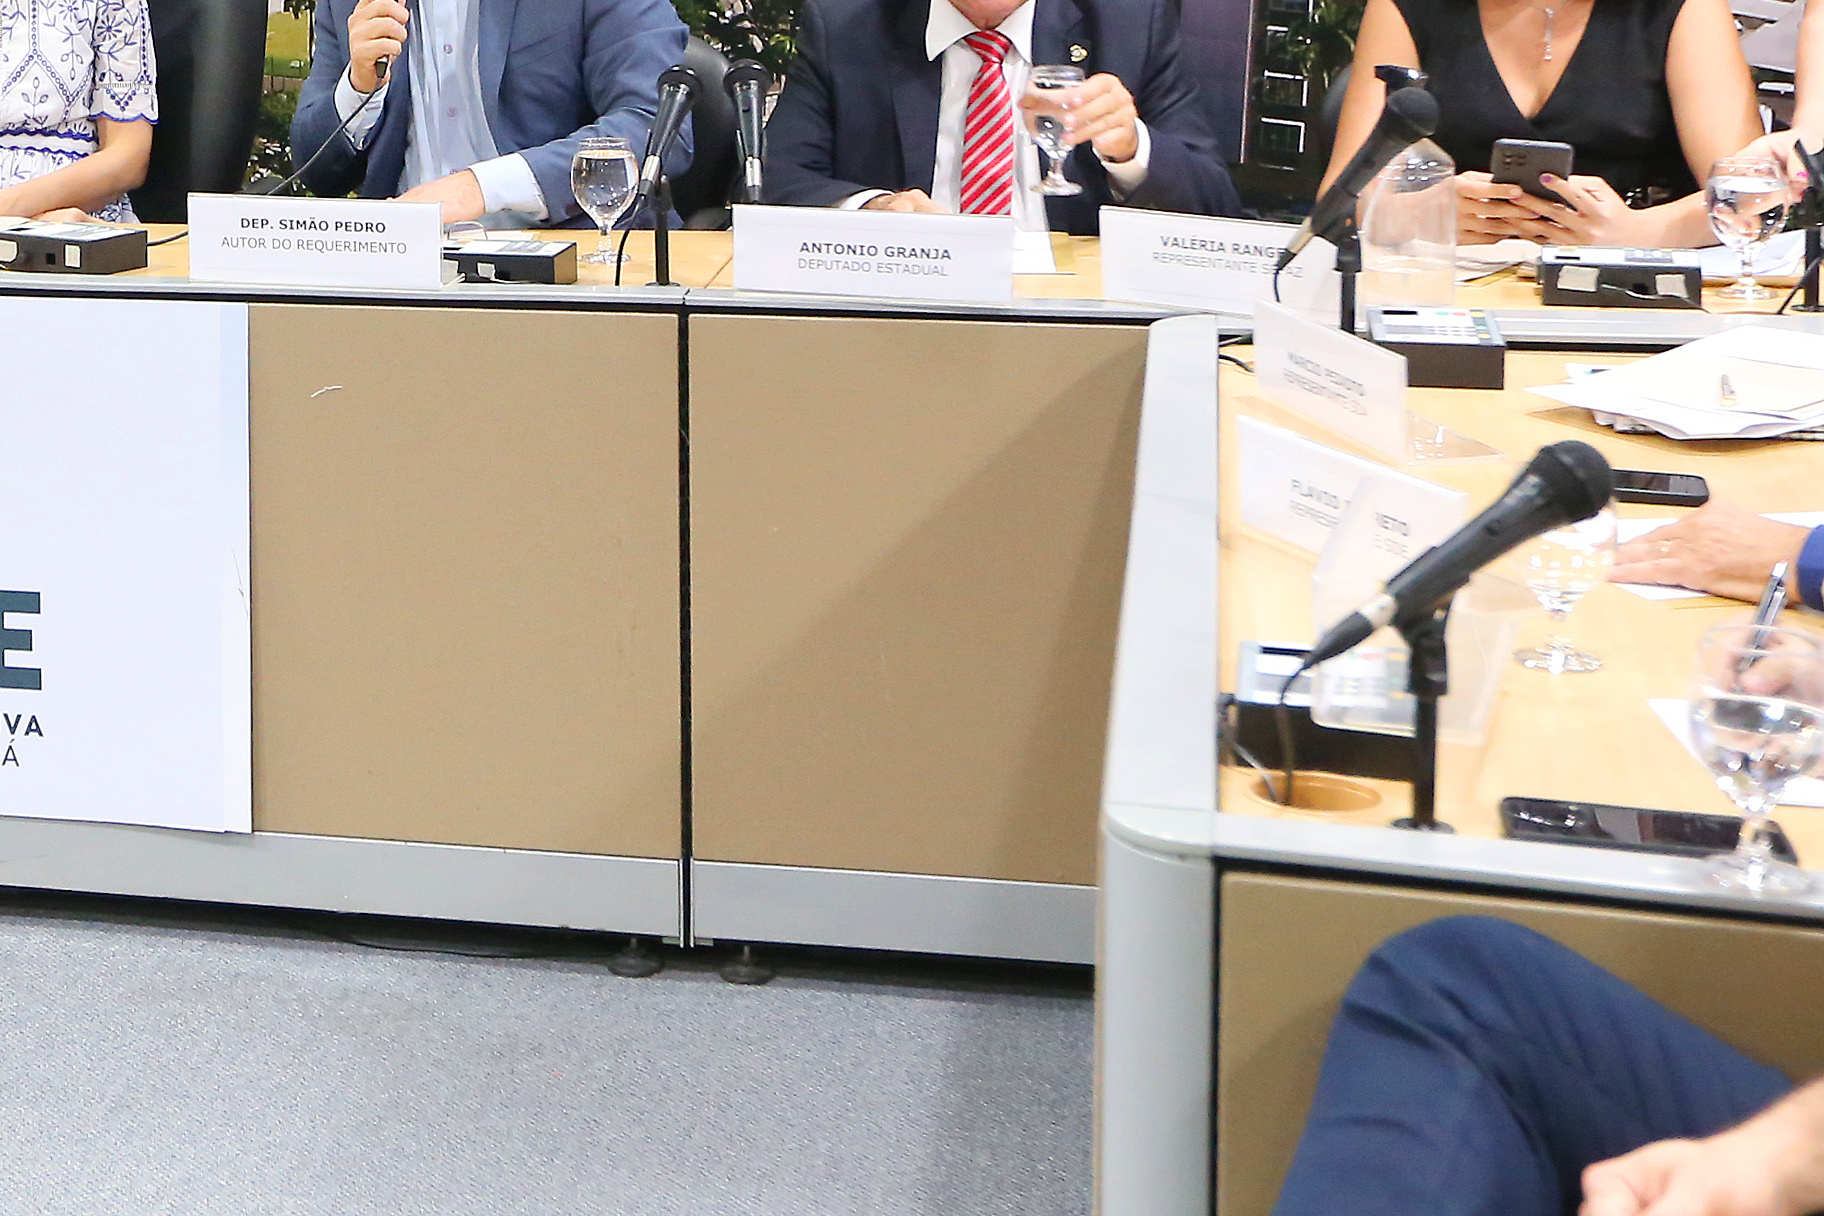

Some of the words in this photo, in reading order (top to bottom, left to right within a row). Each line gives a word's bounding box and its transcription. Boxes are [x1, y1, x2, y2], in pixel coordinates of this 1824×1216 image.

[240, 217, 274, 230] DEP.
[278, 216, 329, 232] SIMÃO
[334, 220, 386, 234] PEDRO
[221, 236, 267, 250] AUTOR
[272, 237, 292, 251] DO
[296, 238, 408, 255] REQUERIMENTO
[799, 241, 879, 257] ANTONIO
[883, 245, 952, 261] GRANJA
[1160, 235, 1226, 253] VALÉRIA
[1232, 242, 1288, 259] RANGE
[797, 257, 872, 273] DEPUTADO
[876, 262, 949, 277] ESTADUAL
[1152, 251, 1258, 274] REPRESENTANTE
[1261, 263, 1304, 278] SEAZ
